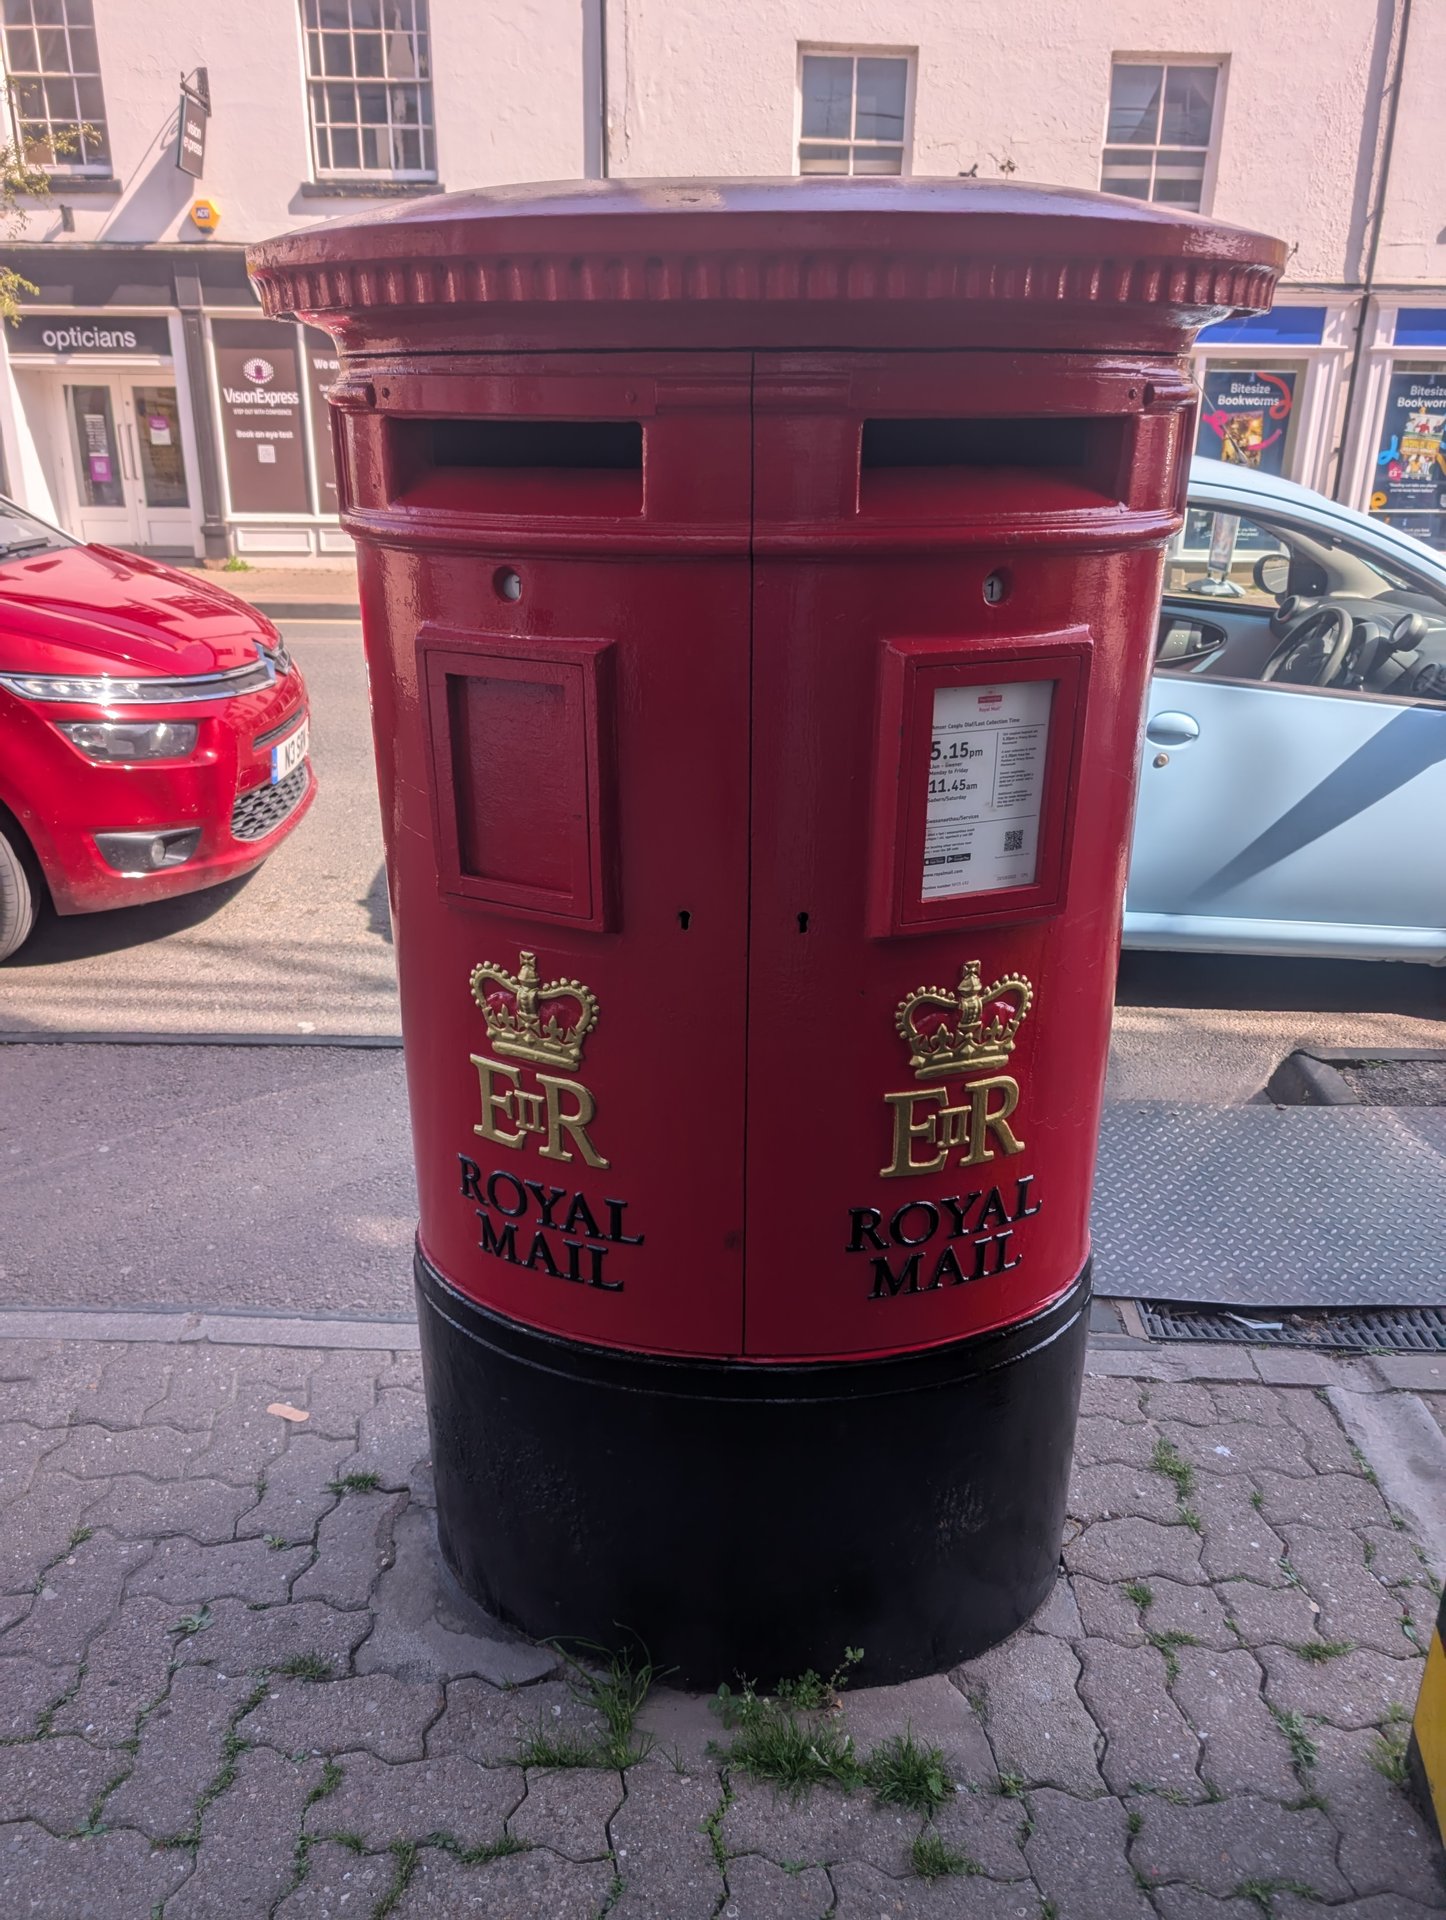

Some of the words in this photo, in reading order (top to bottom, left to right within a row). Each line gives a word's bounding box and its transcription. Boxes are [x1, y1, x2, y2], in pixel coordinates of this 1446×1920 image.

[42, 326, 137, 351] opticians
[223, 387, 300, 407] VisionExpress
[1230, 383, 1271, 395] Bitesize
[1217, 394, 1280, 406] Bookworms
[235, 429, 254, 439] Book
[265, 431, 279, 440] eye
[279, 430, 294, 439] test
[987, 580, 994, 598] 1
[954, 767, 969, 775] Friday
[928, 778, 978, 794] 11.45am
[458, 1152, 644, 1246] ROYAL
[846, 1174, 1043, 1252] ROYAL
[475, 1208, 624, 1293] MAIL
[867, 1229, 1023, 1299] MAIL
